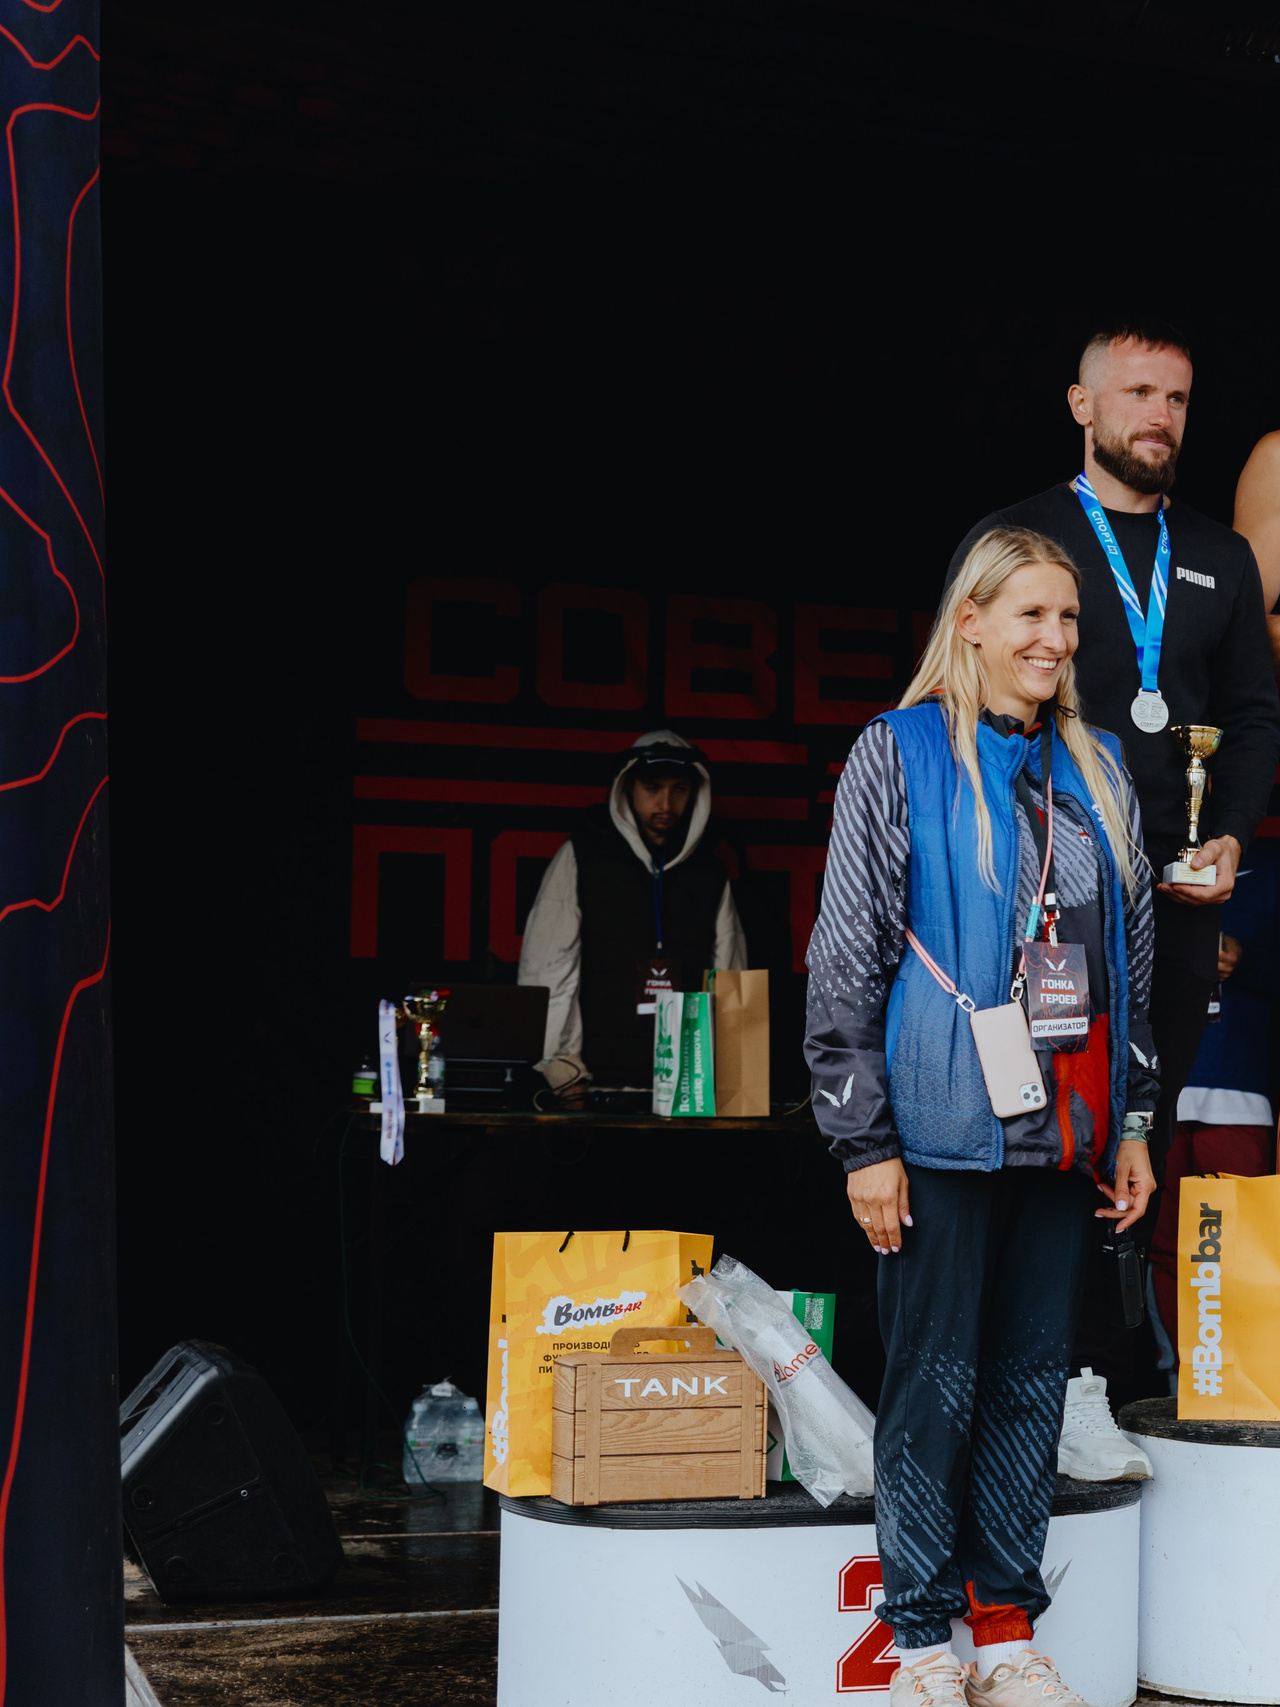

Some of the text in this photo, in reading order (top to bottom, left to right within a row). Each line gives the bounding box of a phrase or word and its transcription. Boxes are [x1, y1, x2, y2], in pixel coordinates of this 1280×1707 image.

[1091, 510, 1113, 544] СПОРТ
[1176, 566, 1216, 590] PUMA
[1042, 979, 1075, 990] ГОНКА
[1040, 993, 1078, 1005] ГЕРОЕВ
[1033, 1021, 1087, 1033] ОРГАНИЗАТОР
[1190, 1203, 1223, 1397] #Bombbar
[614, 1376, 729, 1398] TANK
